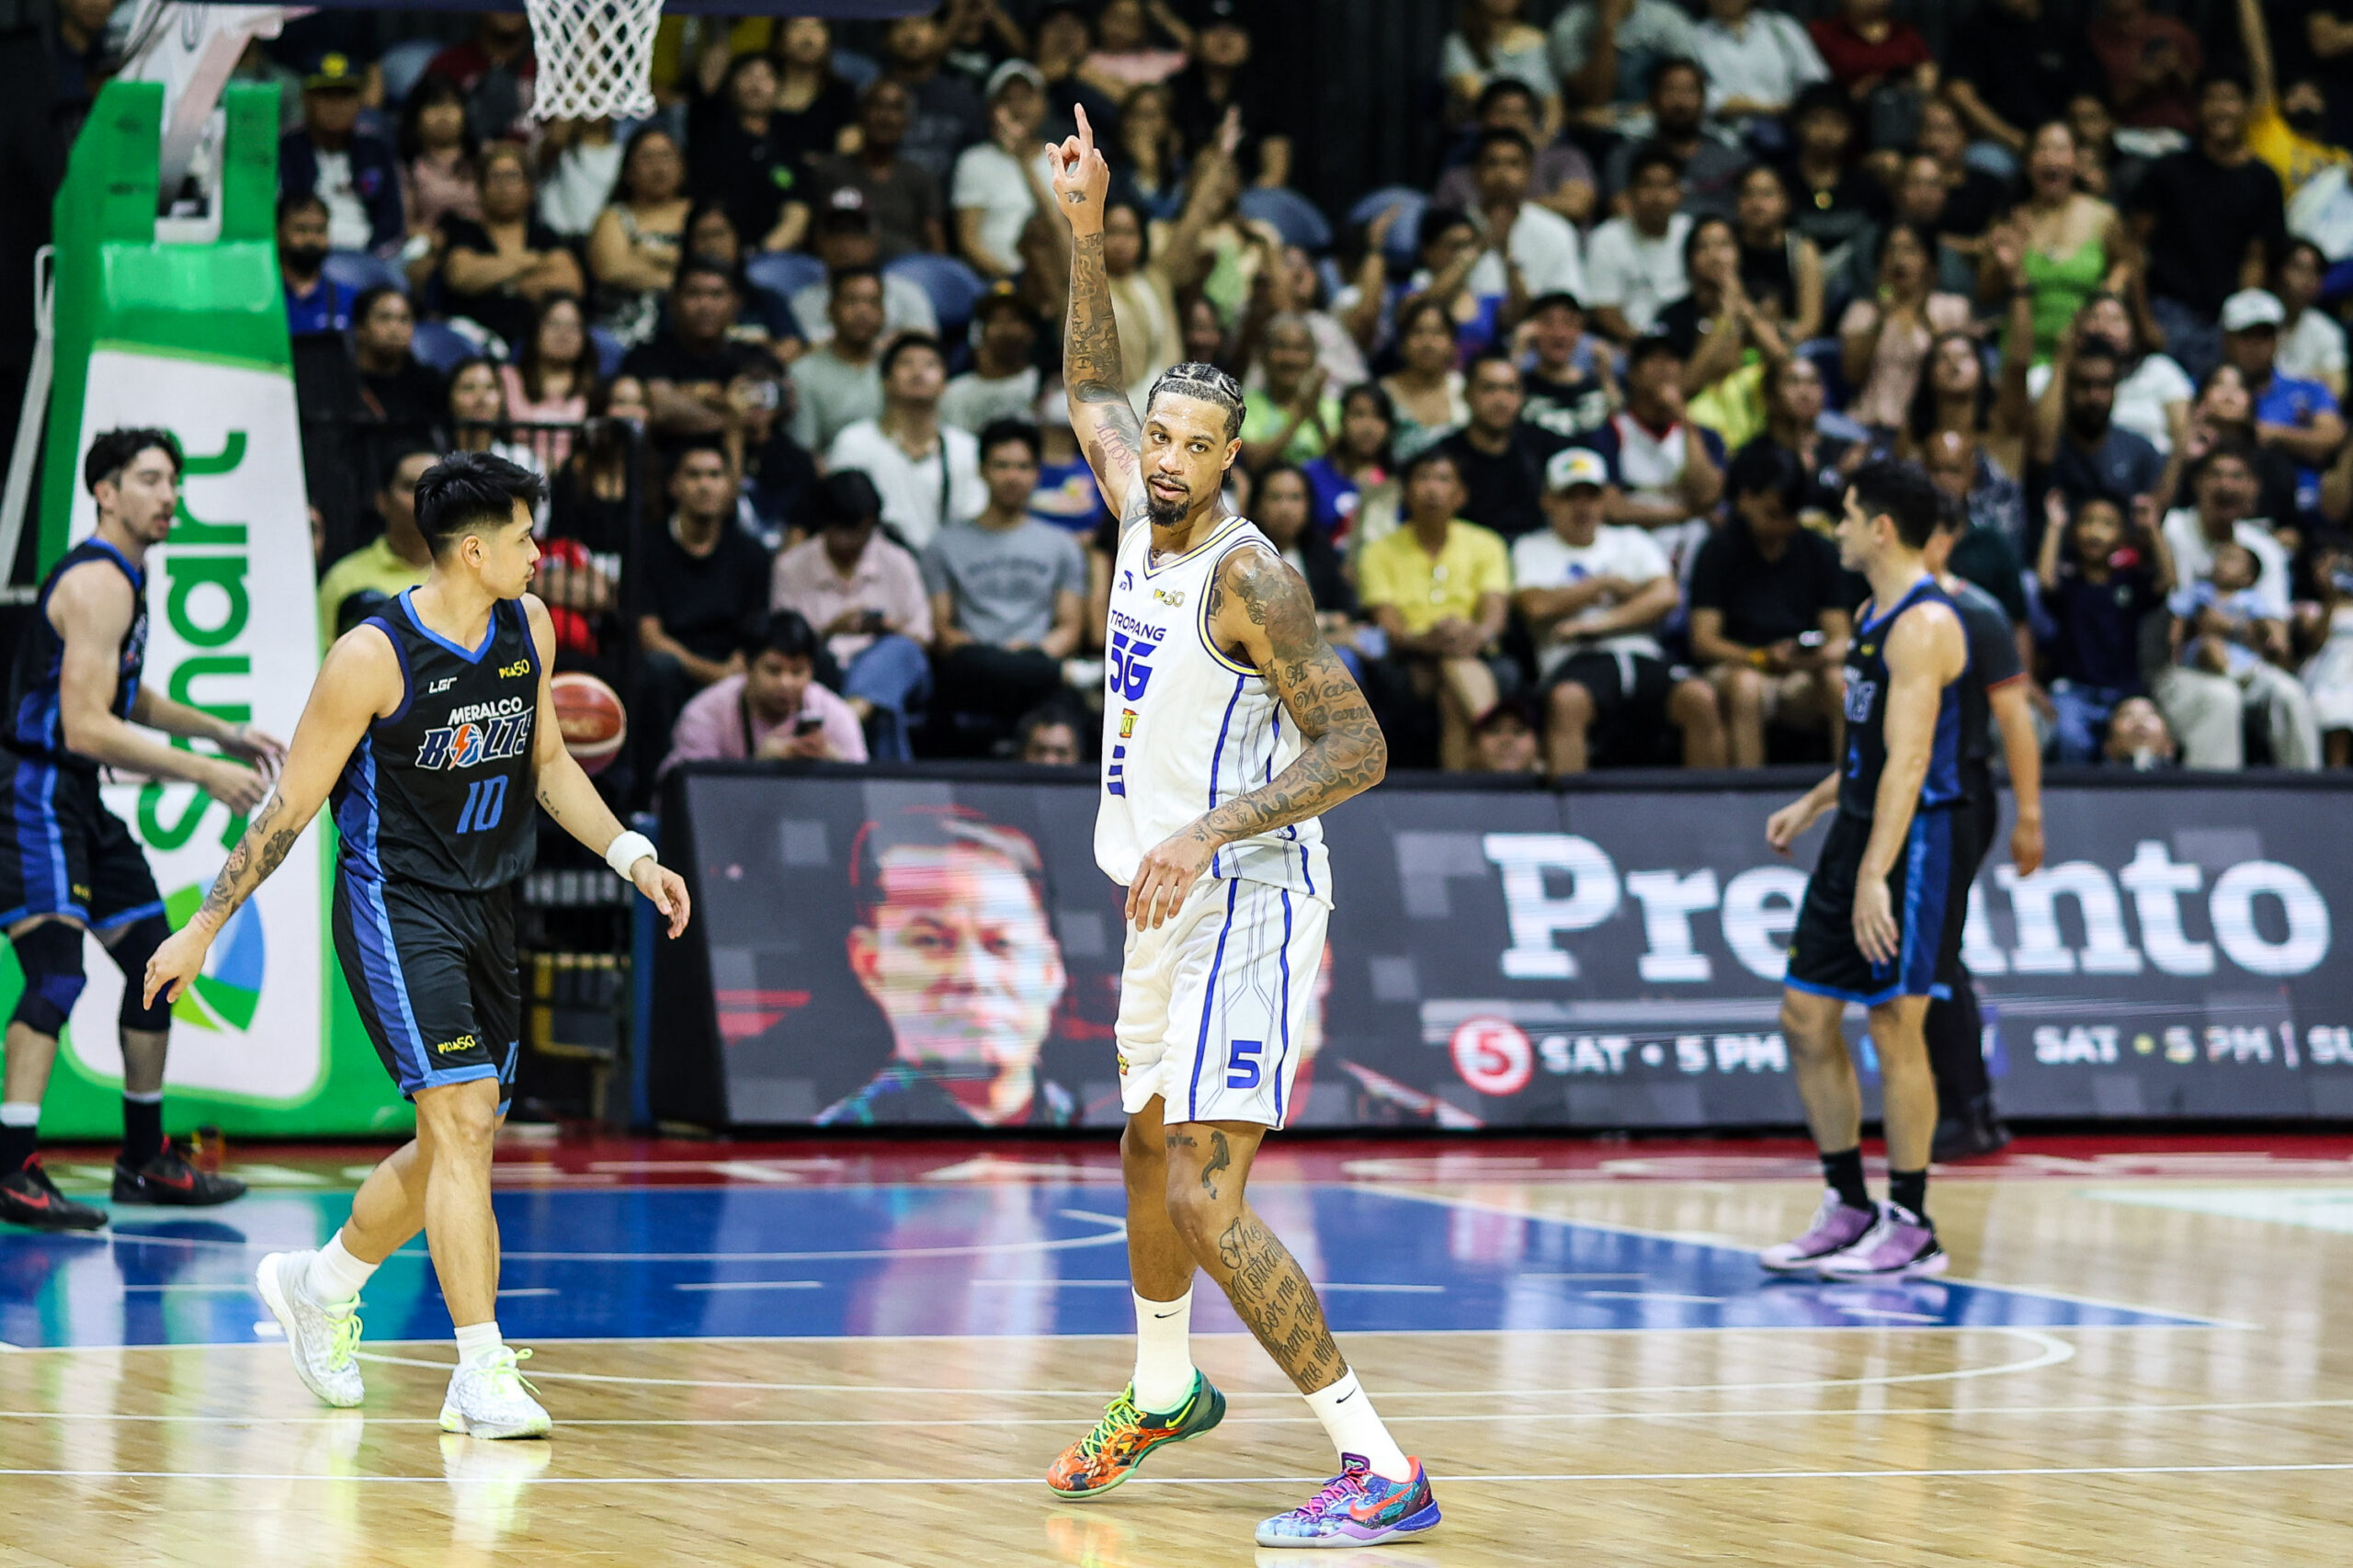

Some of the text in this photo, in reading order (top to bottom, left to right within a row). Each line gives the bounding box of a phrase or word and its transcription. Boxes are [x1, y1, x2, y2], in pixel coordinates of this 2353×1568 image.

[1110, 609, 1166, 642] TROPANG
[1109, 629, 1157, 701] 5G
[448, 696, 523, 726] MERALCO
[456, 774, 508, 834] 10
[1483, 831, 2332, 982] Prento
[1227, 1040, 1262, 1088] 5
[1476, 1031, 1512, 1076] 5
[1539, 1032, 1790, 1074] SAT 5 PM
[2032, 1024, 2120, 1064] SAT
[2205, 1025, 2274, 1063] PM
